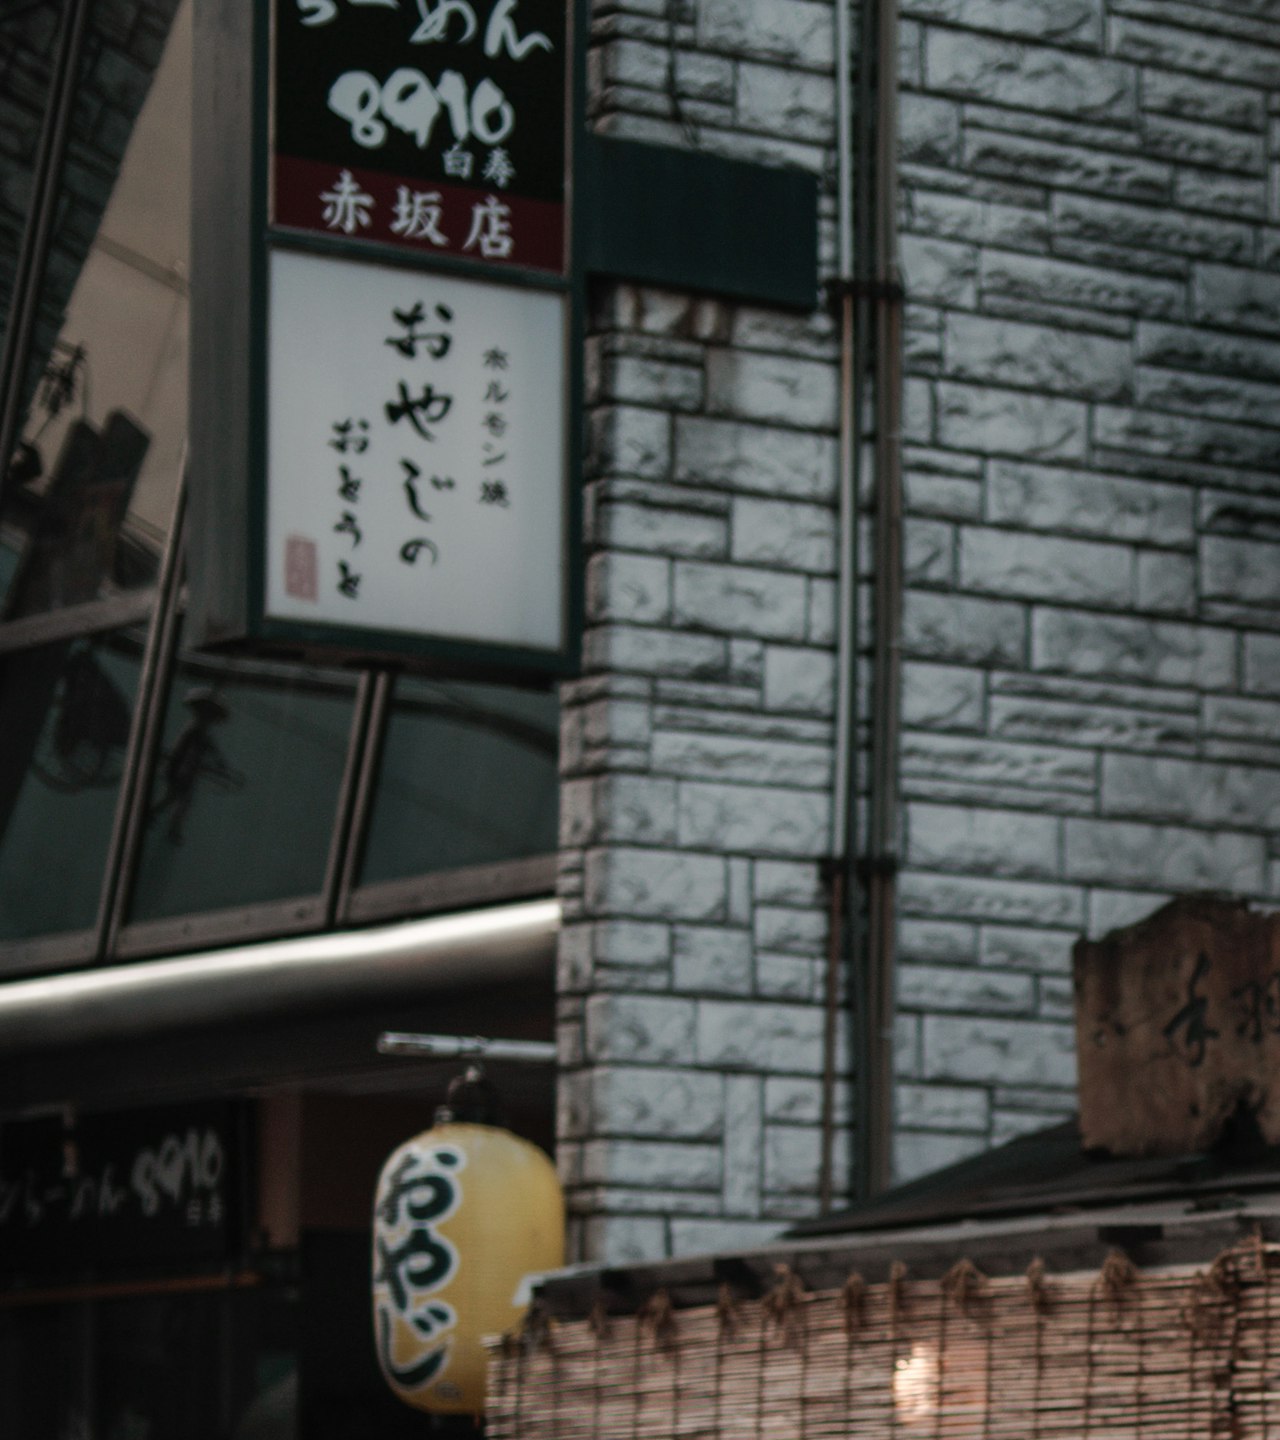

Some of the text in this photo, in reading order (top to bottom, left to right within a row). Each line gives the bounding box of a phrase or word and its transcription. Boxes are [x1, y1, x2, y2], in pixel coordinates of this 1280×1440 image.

[328, 67, 514, 148] 8910
[319, 168, 513, 258] 赤坂店
[384, 300, 455, 566] おやじの
[375, 1149, 457, 1388] おやじ
